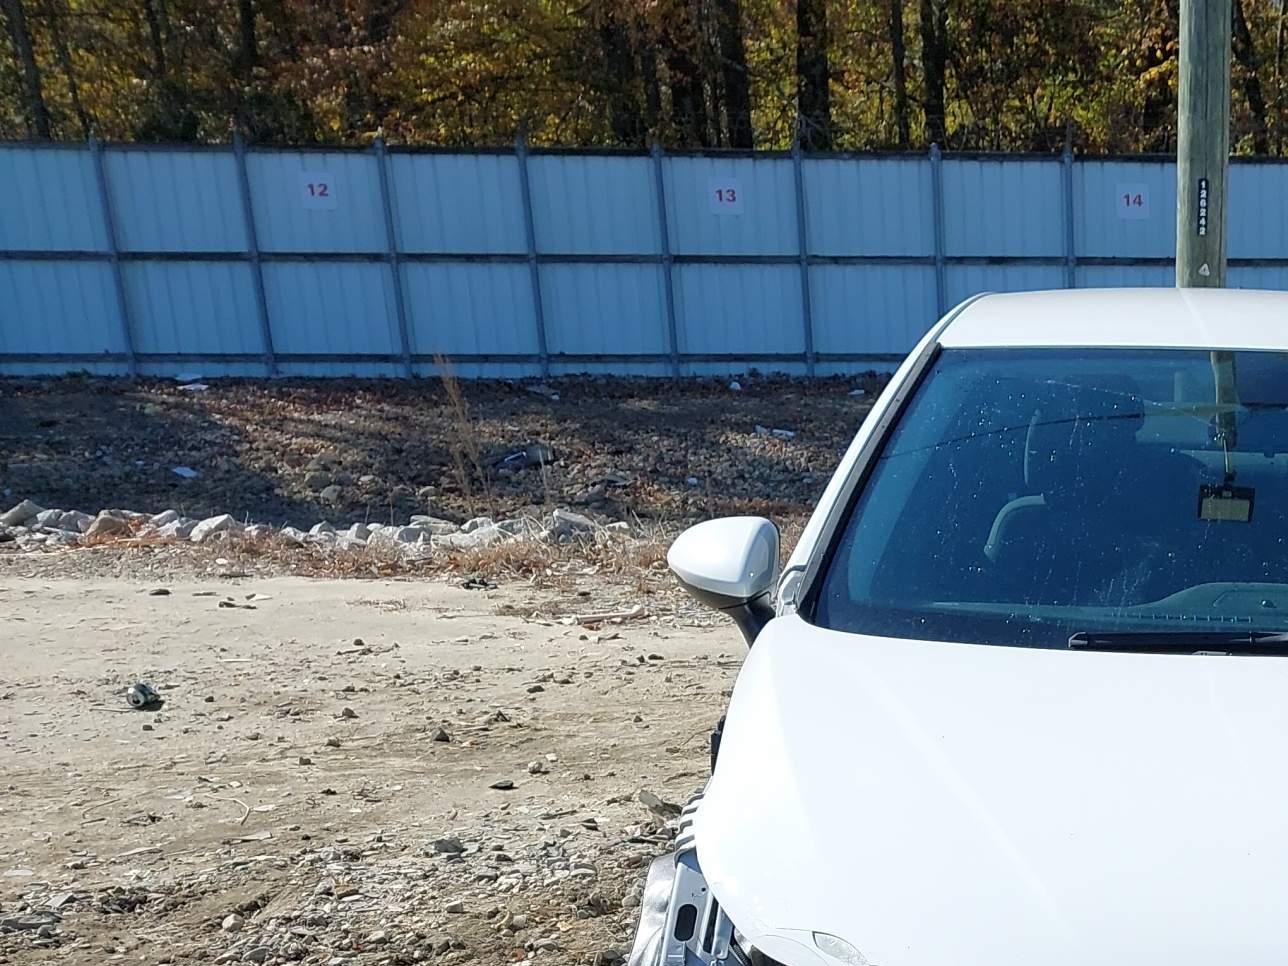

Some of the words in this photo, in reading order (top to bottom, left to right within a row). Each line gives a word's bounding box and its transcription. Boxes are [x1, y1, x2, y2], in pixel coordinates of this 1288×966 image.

[307, 183, 329, 197] 12
[715, 189, 737, 202] 13
[1123, 194, 1144, 207] 14
